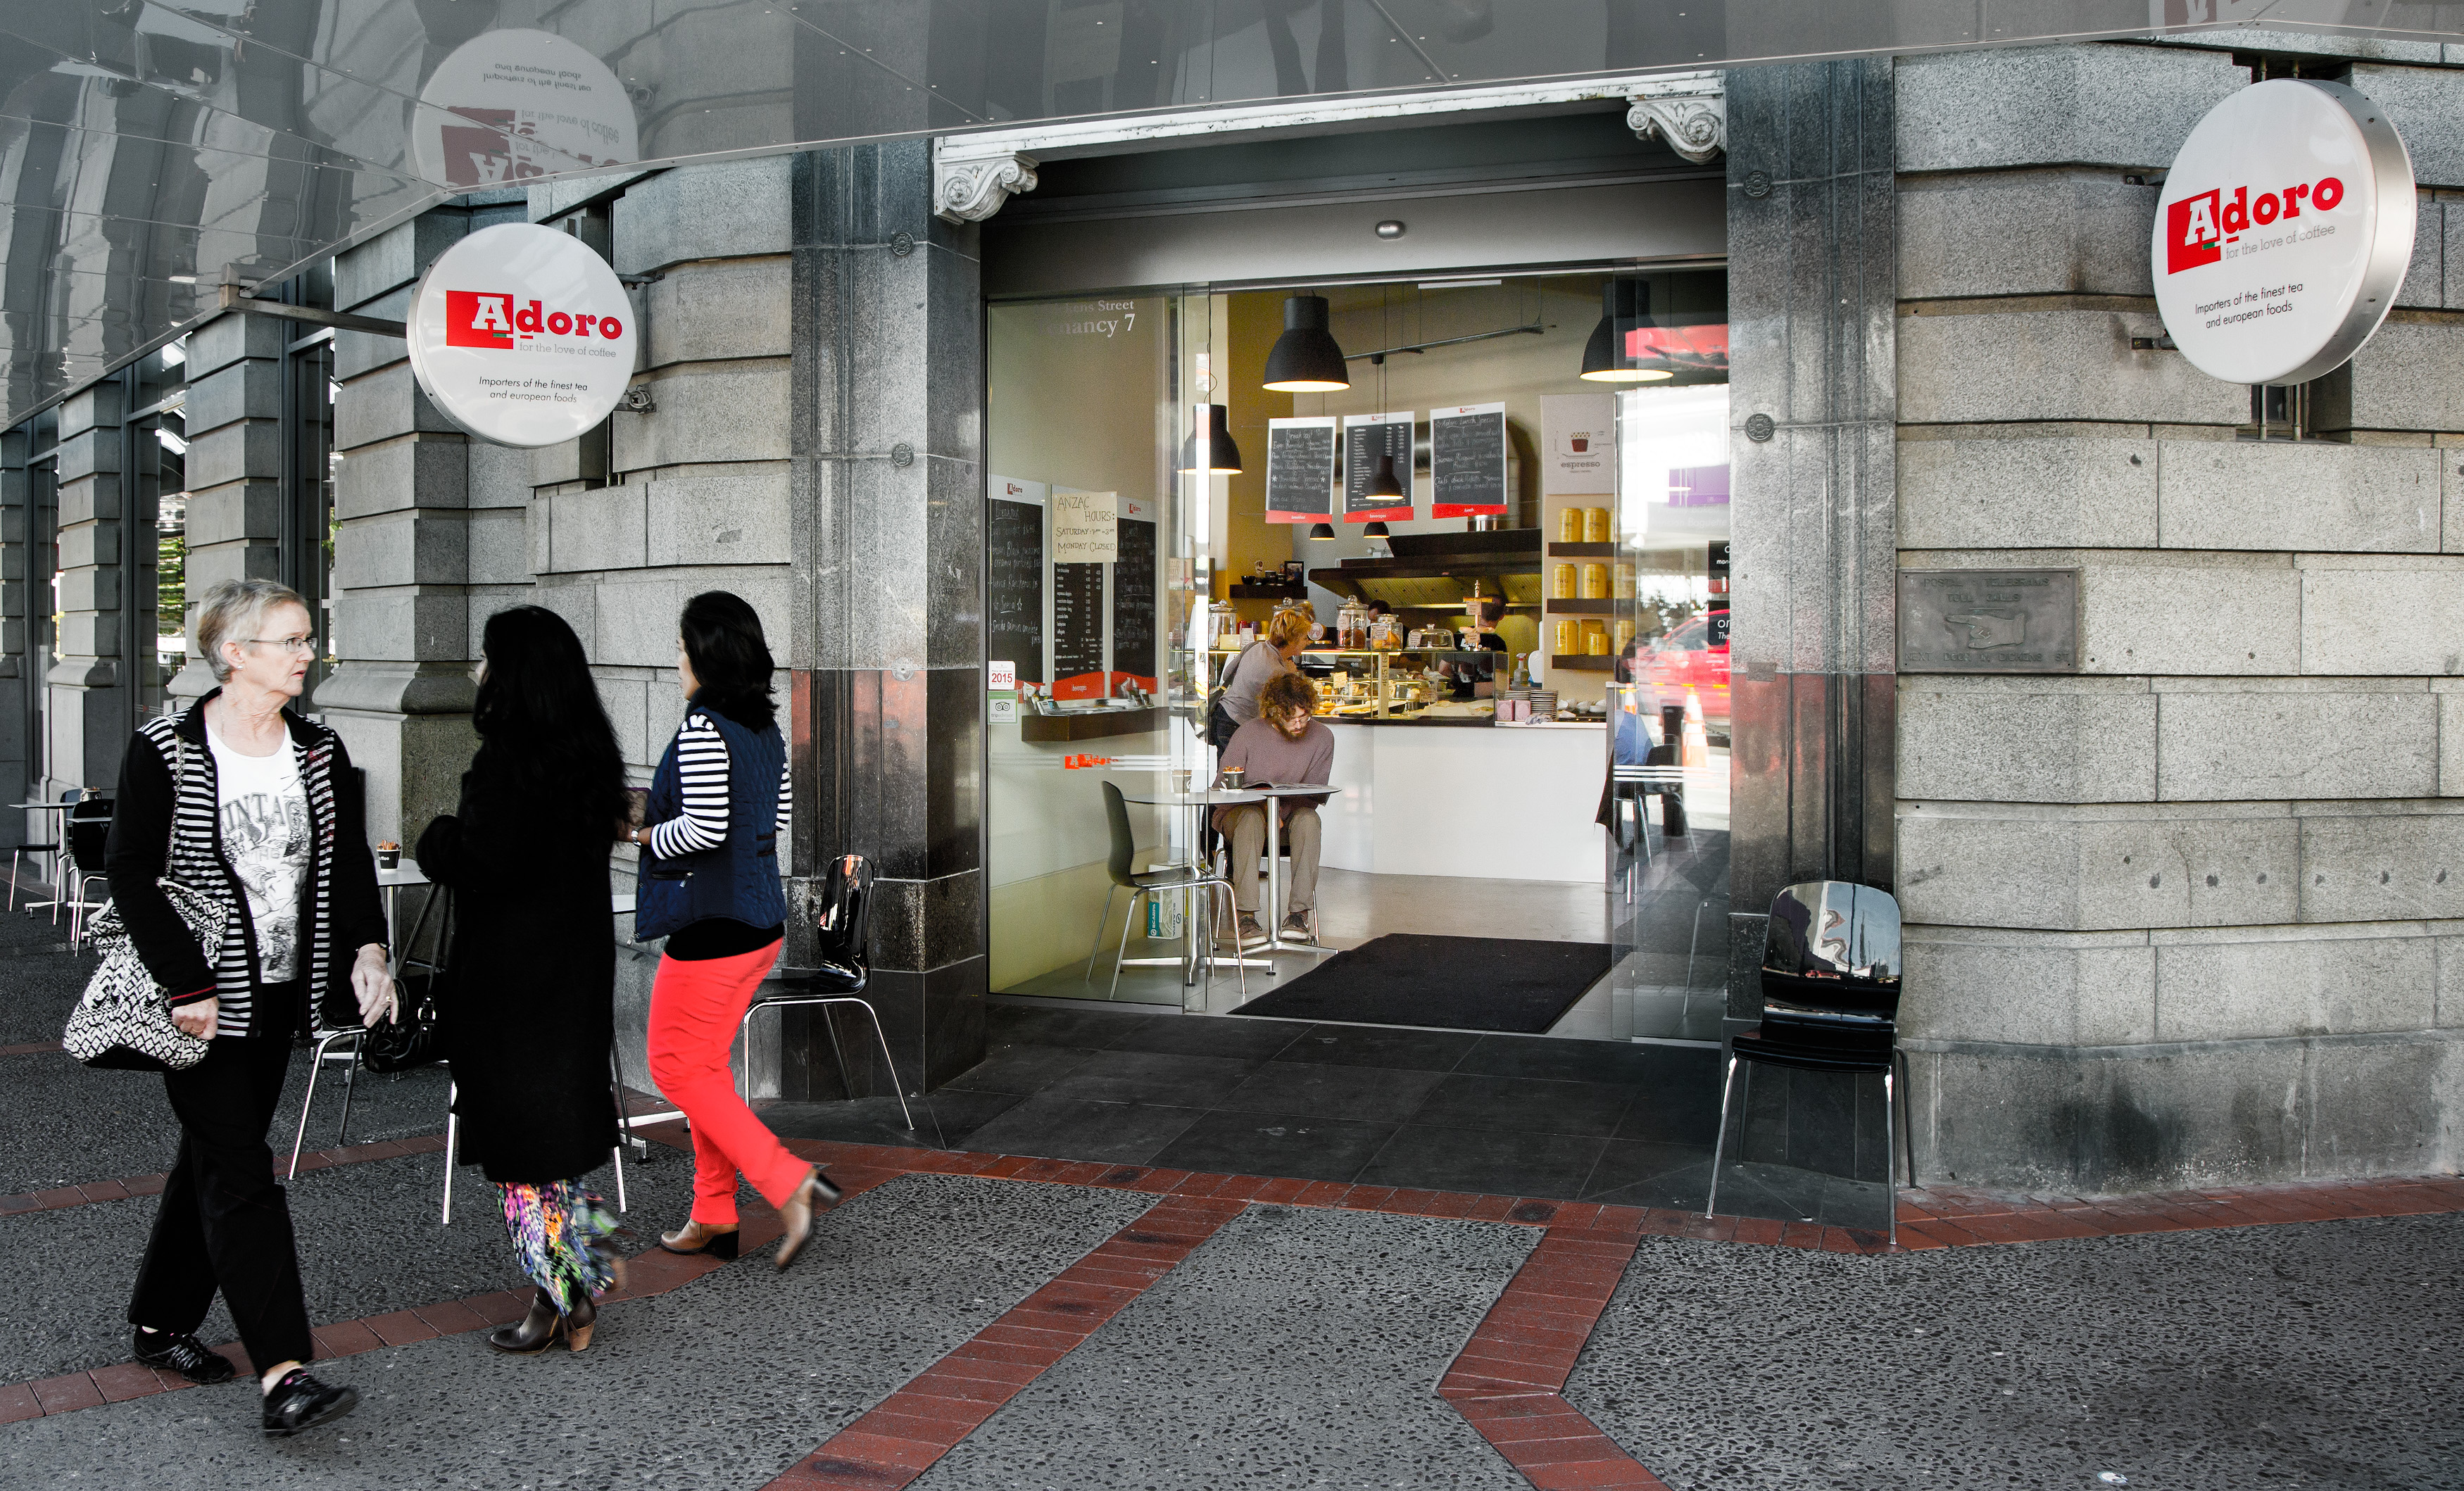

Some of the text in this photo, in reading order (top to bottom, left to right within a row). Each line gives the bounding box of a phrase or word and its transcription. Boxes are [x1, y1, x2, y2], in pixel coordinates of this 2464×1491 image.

[2184, 177, 2344, 246] Adoro
[2225, 223, 2335, 260] for the love of coffee
[2194, 282, 2303, 315] Importers of the finest tea
[1098, 300, 1134, 311] Street
[471, 296, 623, 339] Adoro
[2205, 302, 2293, 329] and european foods
[1124, 313, 1136, 332] 7
[520, 343, 617, 358] for the love of coffee
[479, 377, 588, 391] Importers of the finest tea
[490, 391, 577, 403] and european foods
[1561, 461, 1601, 470] espresso
[1057, 496, 1089, 511] ANZAC
[1084, 511, 1114, 522] HOURS:
[1058, 542, 1116, 553] MONDAY CLOSED
[1923, 577, 2050, 587] POSTAL TELEGRAMS
[1946, 593, 2020, 603] TOLL CALLS
[1905, 652, 1932, 662] NEXT
[1943, 652, 1970, 662] DOOR
[1980, 652, 1991, 662] IN
[1999, 652, 2043, 662] DICKENS
[991, 673, 1012, 683] 2015
